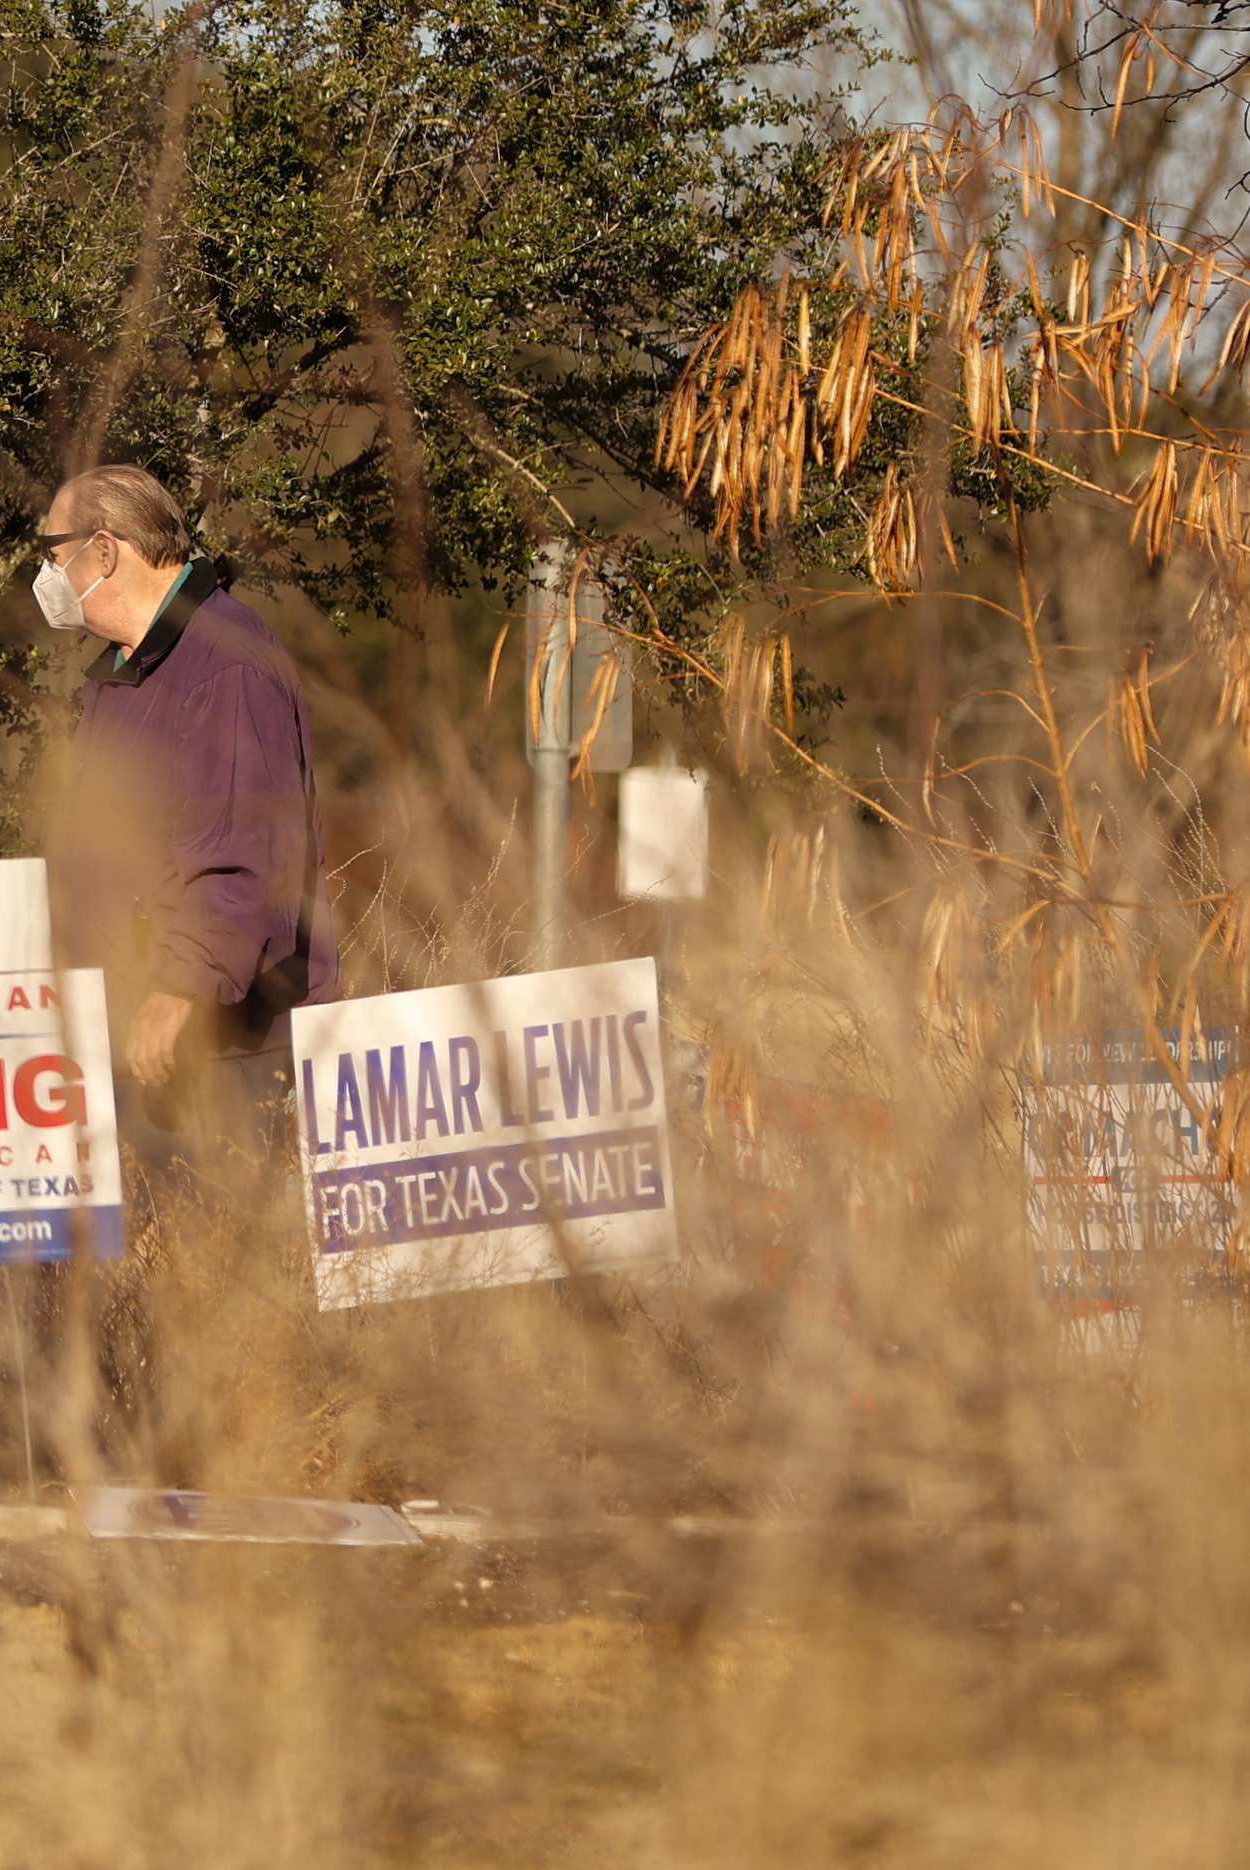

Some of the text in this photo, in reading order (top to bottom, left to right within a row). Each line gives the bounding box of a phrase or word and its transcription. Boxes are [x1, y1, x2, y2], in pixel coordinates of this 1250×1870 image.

[302, 1010, 655, 1155] LAMAR LEWIS
[10, 1173, 95, 1198] TEXAS
[318, 1142, 656, 1239] FOR TEXAS SENATE
